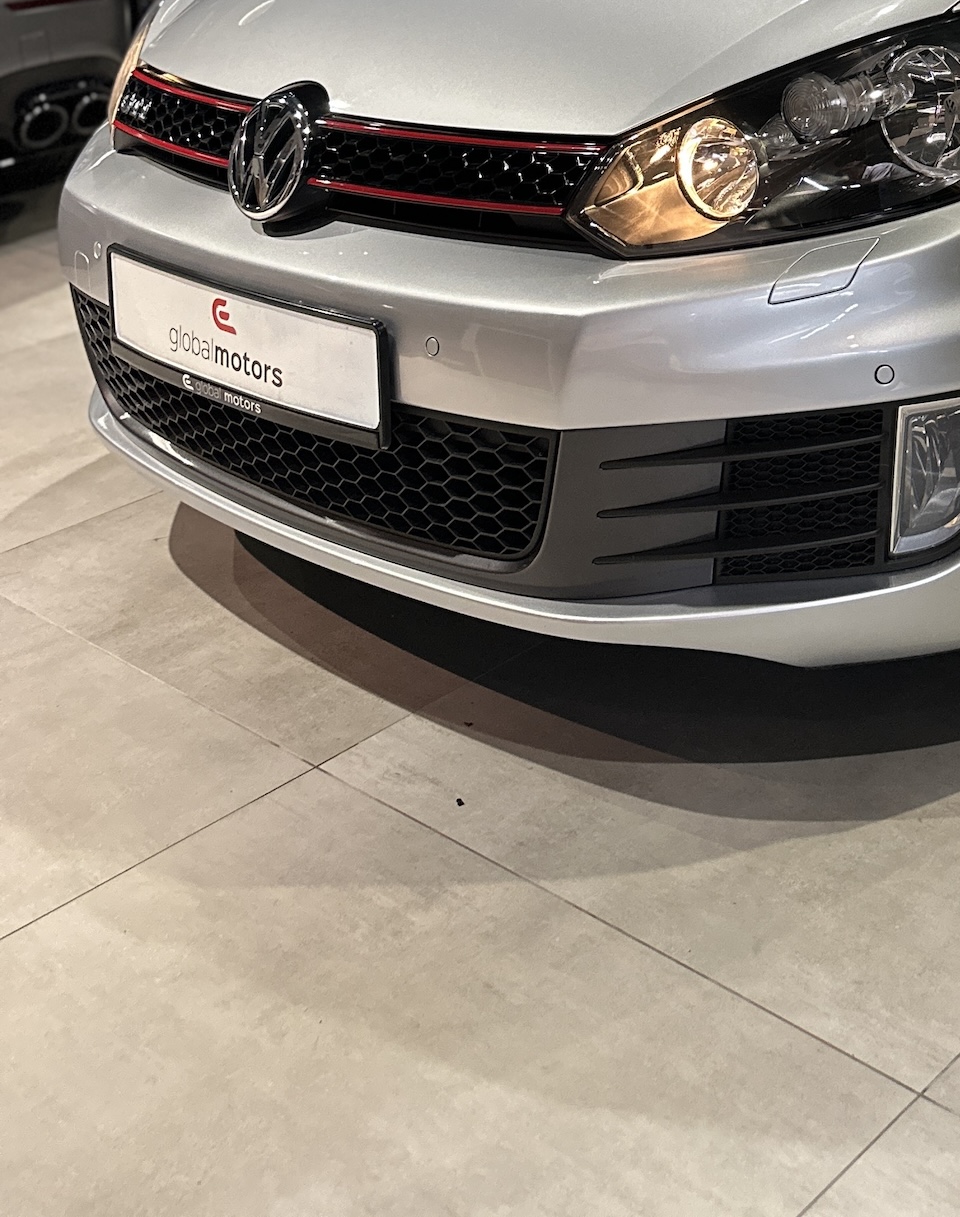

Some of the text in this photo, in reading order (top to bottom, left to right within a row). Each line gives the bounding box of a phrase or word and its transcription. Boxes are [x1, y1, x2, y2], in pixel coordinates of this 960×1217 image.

[169, 325, 283, 388] globalmotors
[195, 380, 262, 414] global motors
